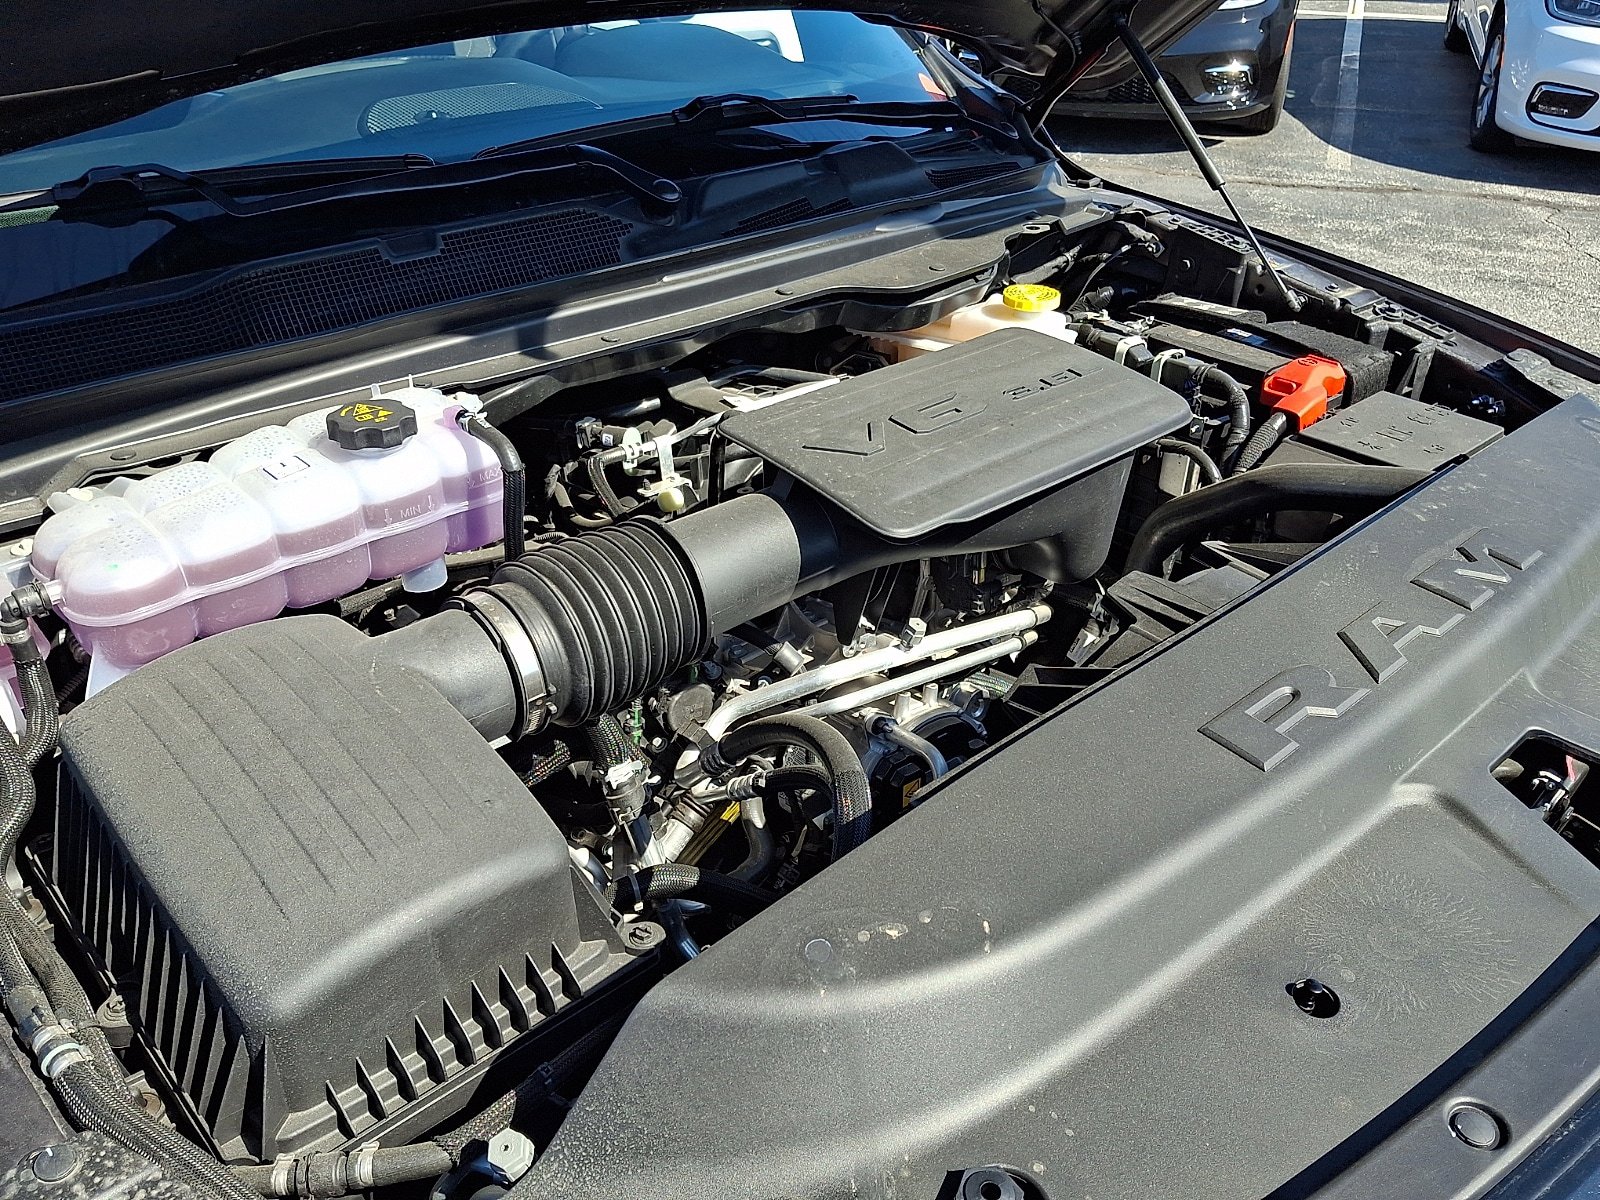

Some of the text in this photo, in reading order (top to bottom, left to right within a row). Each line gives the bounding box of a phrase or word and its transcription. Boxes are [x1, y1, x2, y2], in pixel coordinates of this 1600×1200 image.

[801, 367, 1103, 458] V6 3.6L
[479, 466, 502, 482] MAX
[400, 504, 422, 520] MIN
[1196, 527, 1546, 773] RAM
